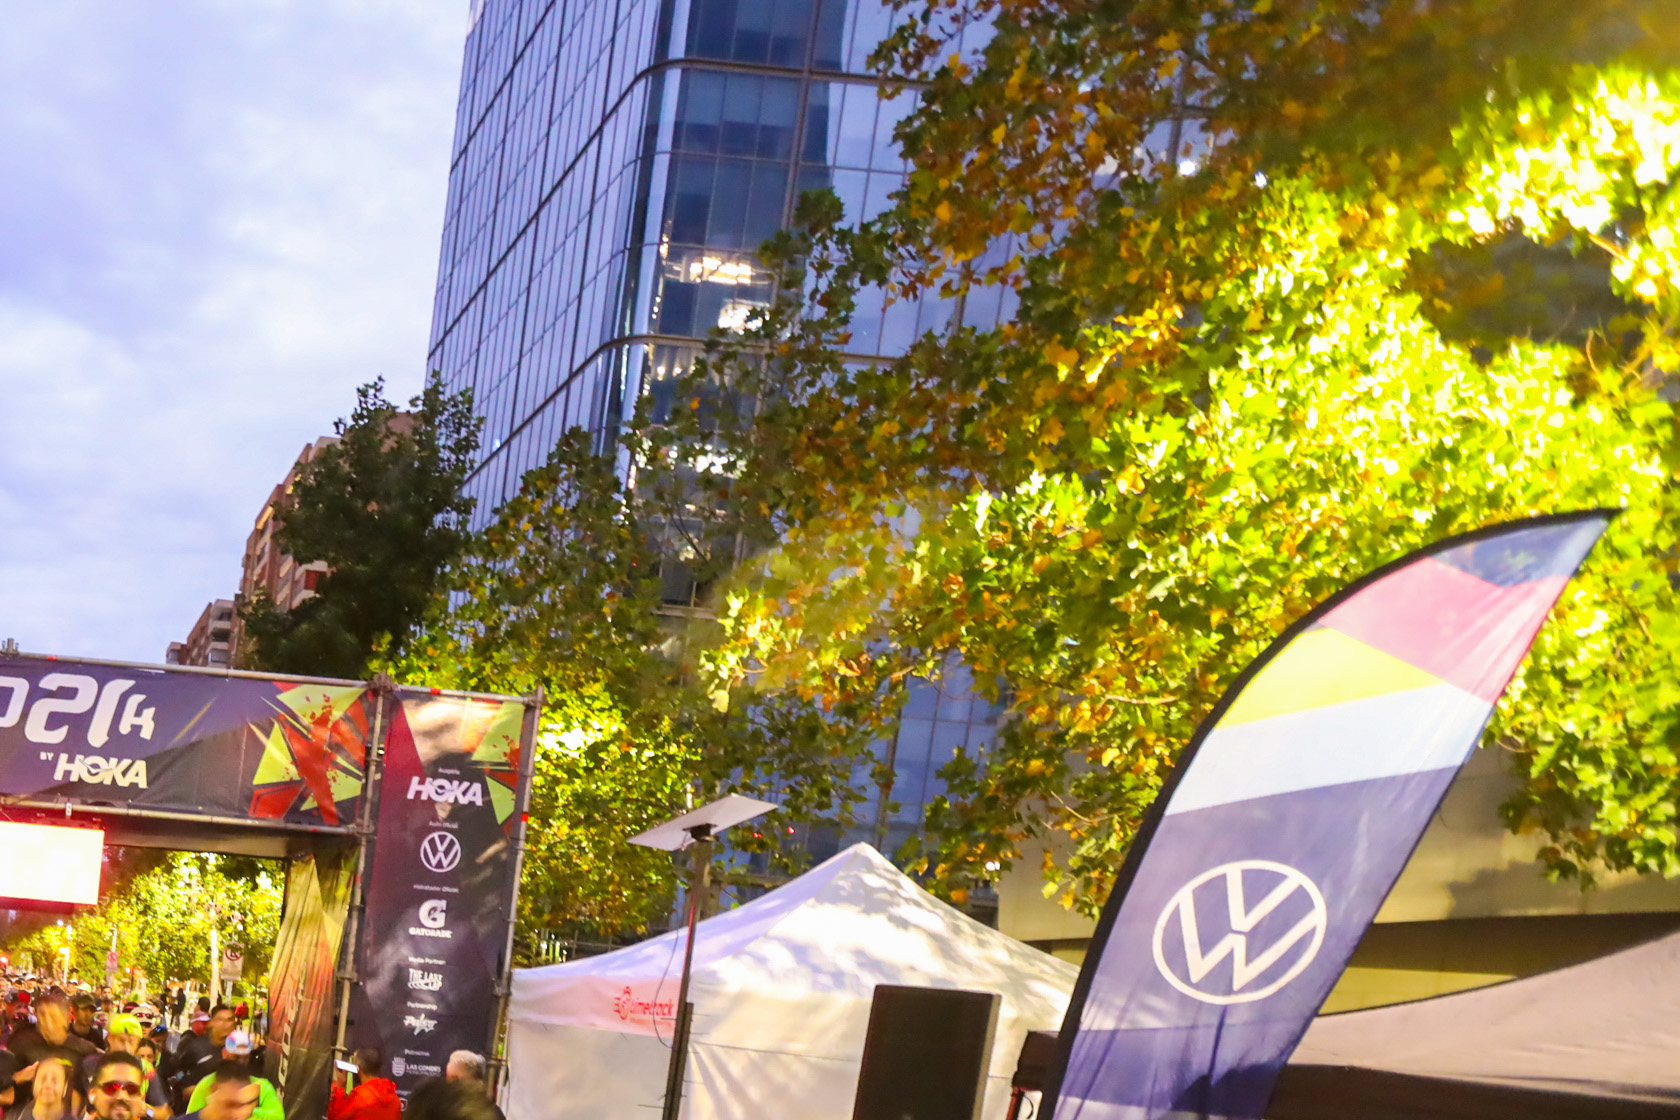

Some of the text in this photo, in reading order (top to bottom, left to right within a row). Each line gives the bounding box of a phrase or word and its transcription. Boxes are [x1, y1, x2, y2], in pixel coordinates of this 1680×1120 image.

[40, 752, 148, 789] BY HOKA
[406, 775, 483, 806] HOKA
[409, 927, 453, 938] GATORADE
[418, 1065, 441, 1073] CONDES
